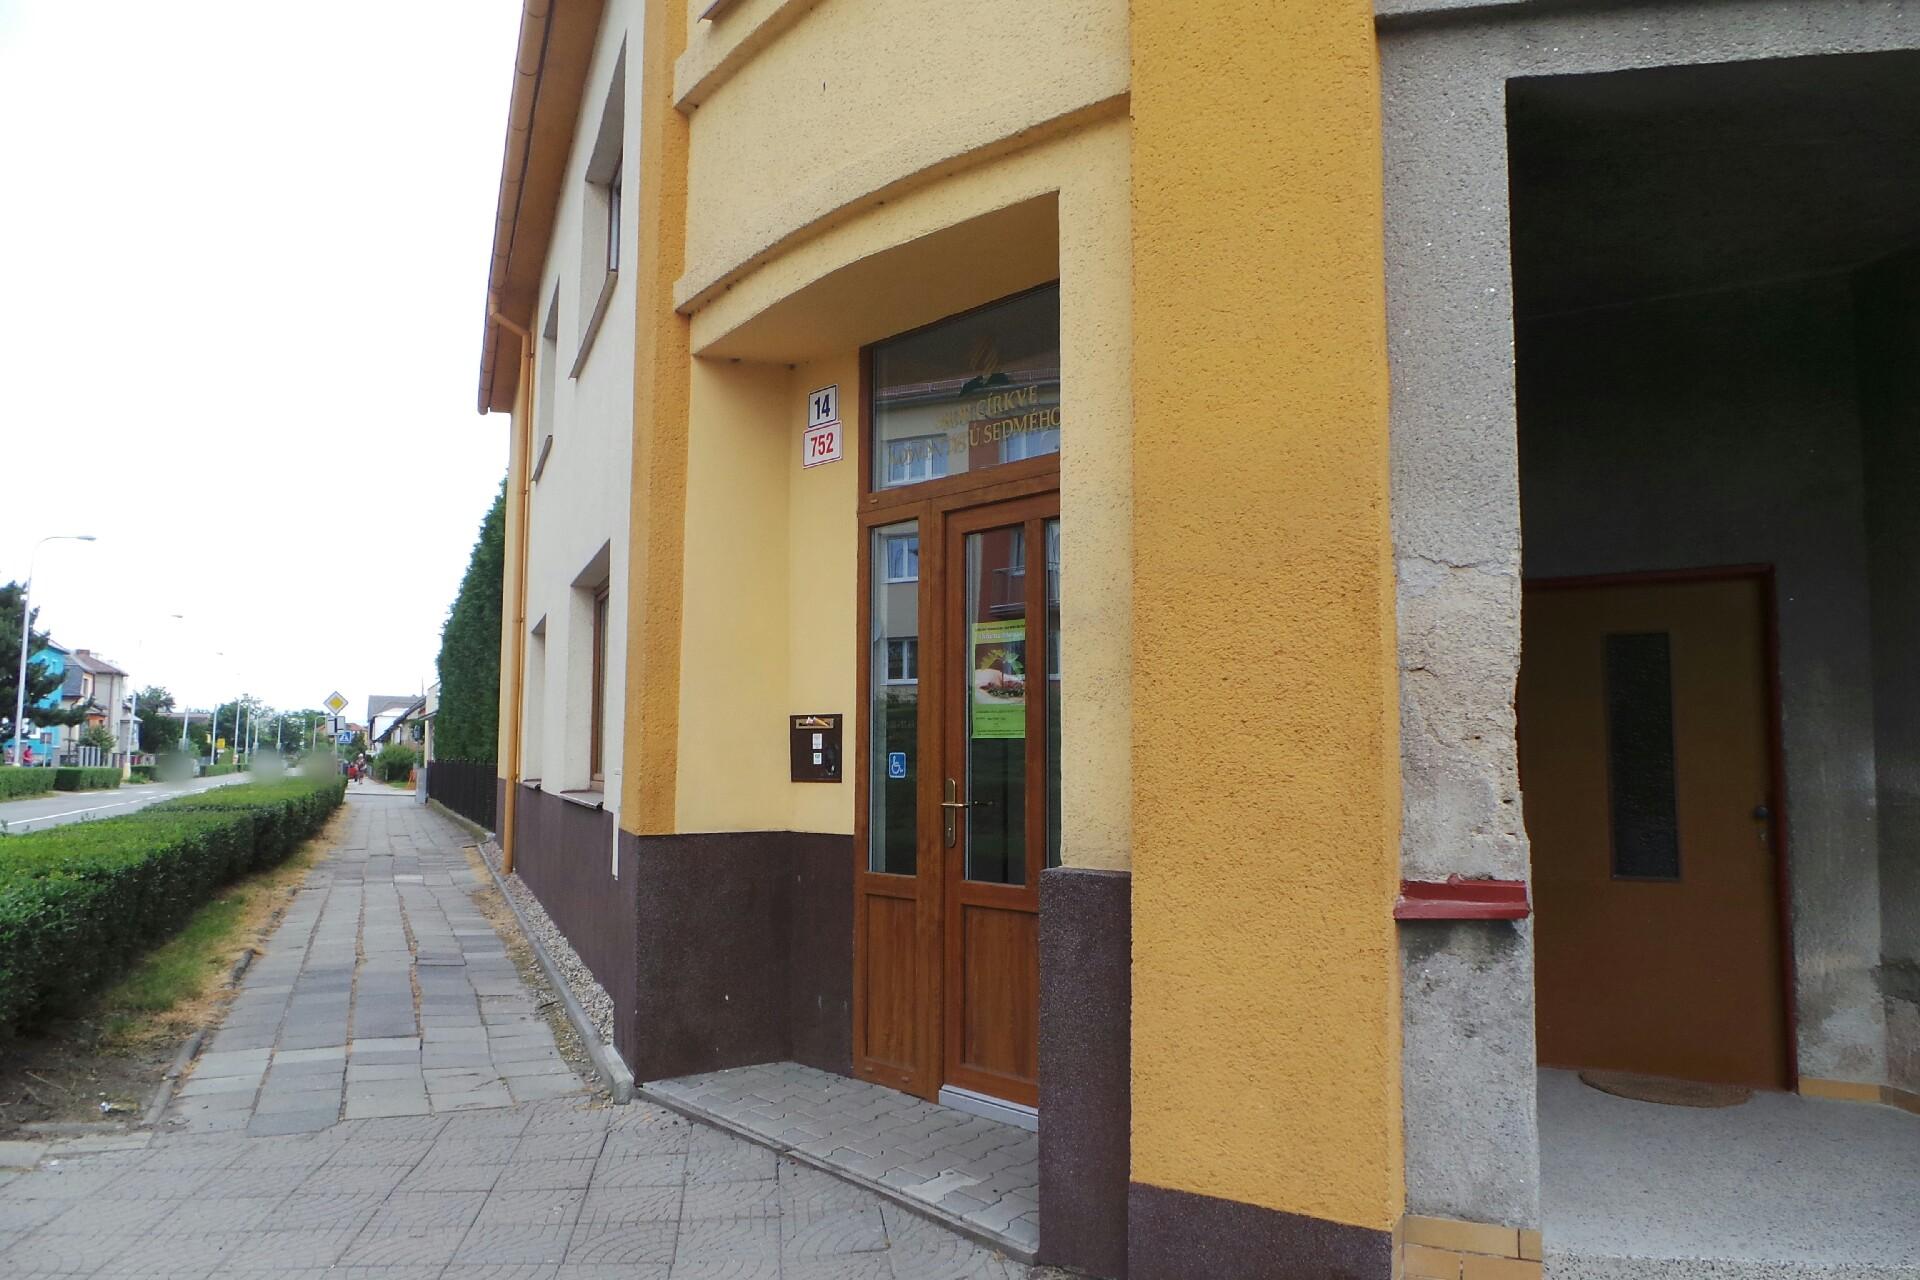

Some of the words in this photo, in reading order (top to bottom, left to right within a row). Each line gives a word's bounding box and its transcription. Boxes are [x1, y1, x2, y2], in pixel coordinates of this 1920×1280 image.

[815, 394, 831, 420] 14
[983, 408, 1060, 444] SEDMÉHO
[811, 432, 834, 457] 752
